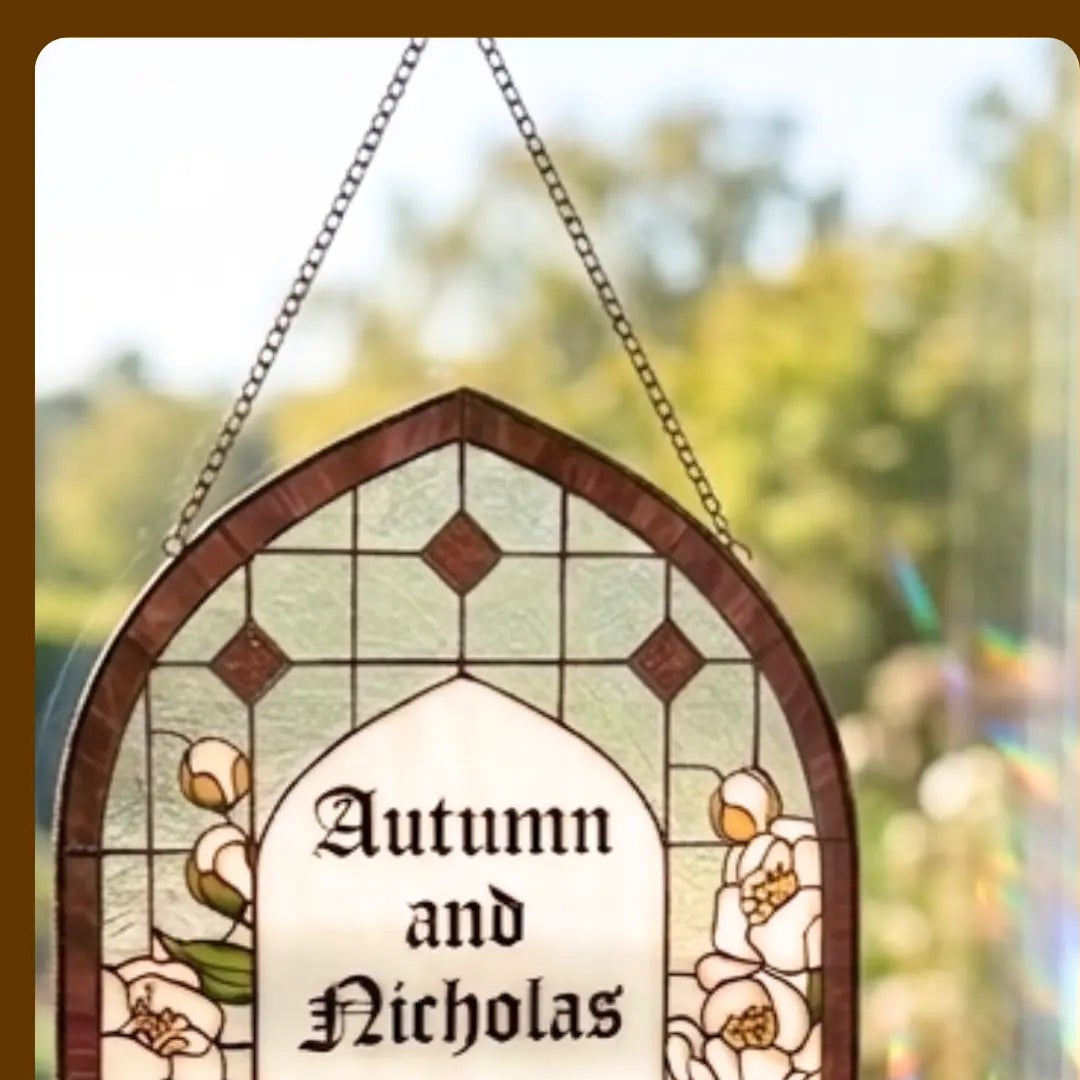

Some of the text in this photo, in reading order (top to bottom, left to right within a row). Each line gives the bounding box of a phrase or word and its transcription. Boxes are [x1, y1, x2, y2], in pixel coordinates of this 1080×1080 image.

[314, 785, 612, 858] Autumn
[405, 884, 524, 949] and
[297, 974, 624, 1057] Nicholas
